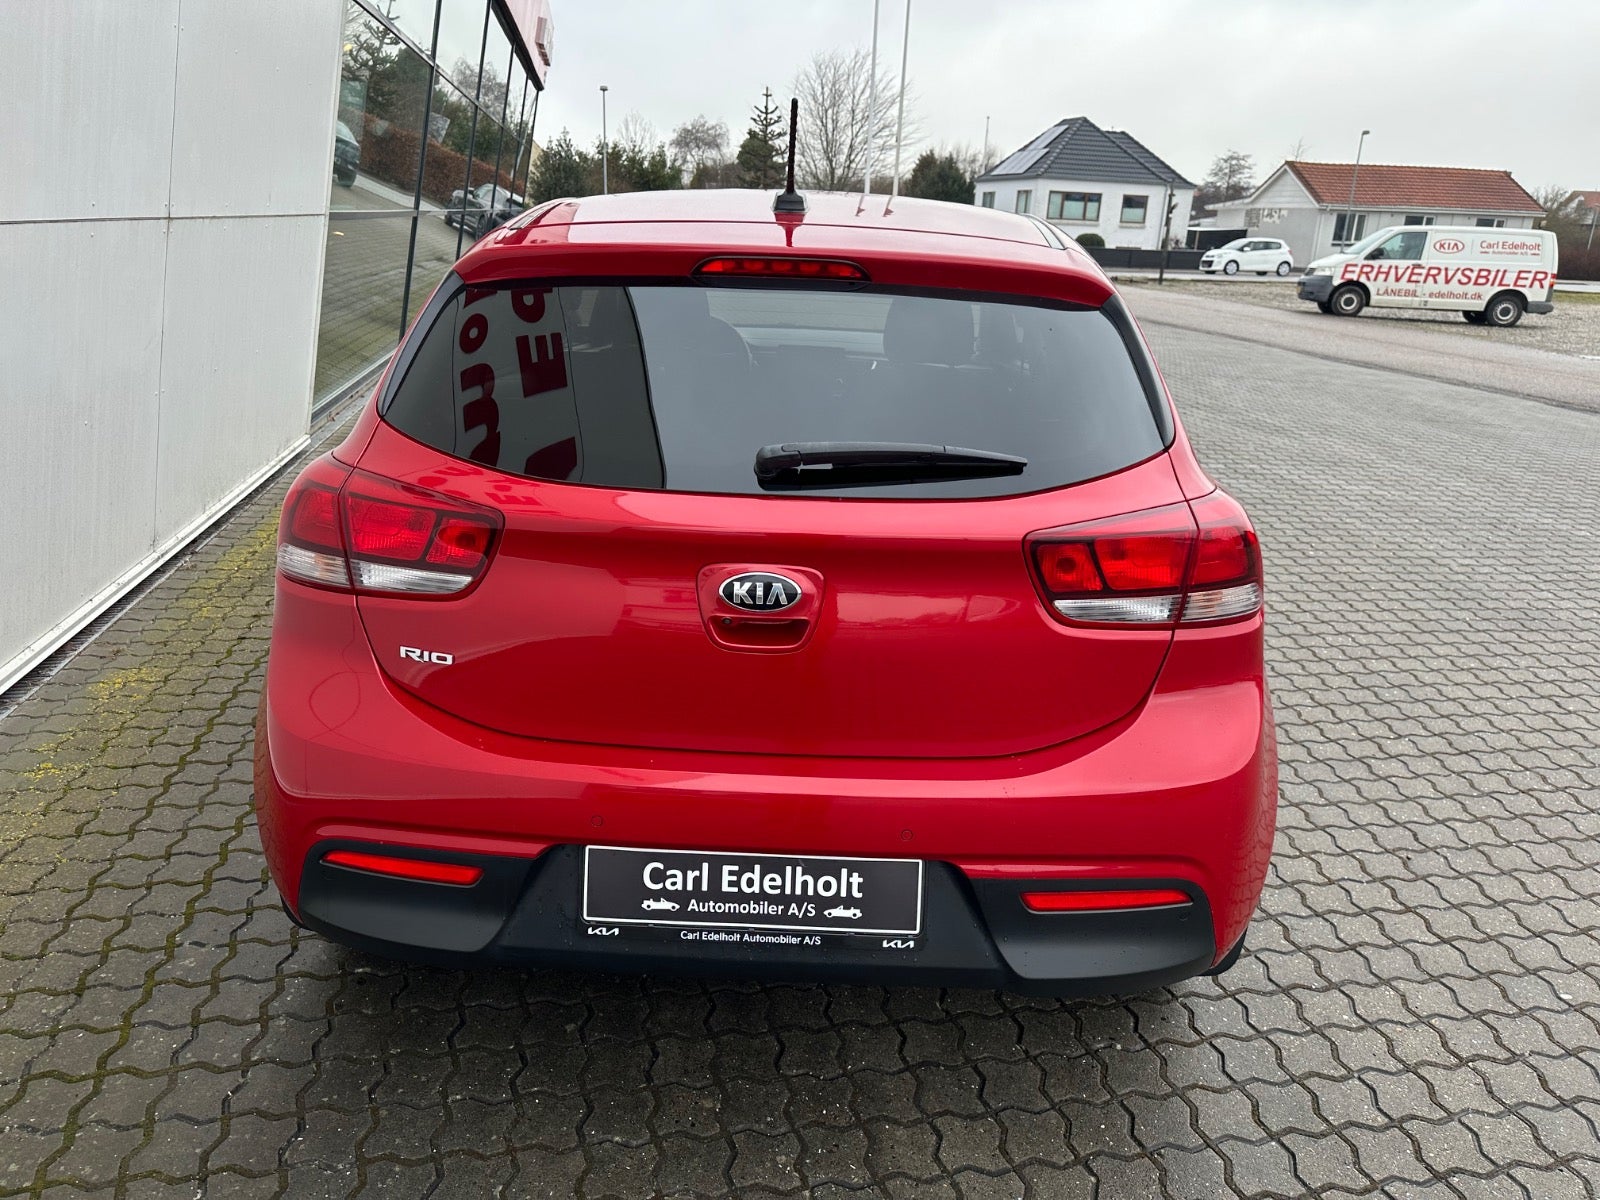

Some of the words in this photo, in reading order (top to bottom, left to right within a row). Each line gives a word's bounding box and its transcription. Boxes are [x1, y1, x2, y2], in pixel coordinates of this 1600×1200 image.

[1480, 240, 1499, 250] Carl
[1501, 241, 1541, 251] Edelholt
[1341, 264, 1547, 288] ERHVERVSBILER
[1376, 287, 1418, 297] LÅNEBIL
[1428, 291, 1483, 300] edelholt.dk
[733, 581, 788, 605] KIA
[399, 645, 454, 666] RIO
[642, 862, 709, 892] Carl
[721, 864, 864, 899] Edelholt
[687, 898, 784, 916] Automobiler
[787, 903, 816, 918] A/S
[680, 931, 700, 940] Carl
[701, 932, 741, 942] Edelholt
[742, 934, 802, 945] Automobiler
[803, 936, 821, 945] A/S
